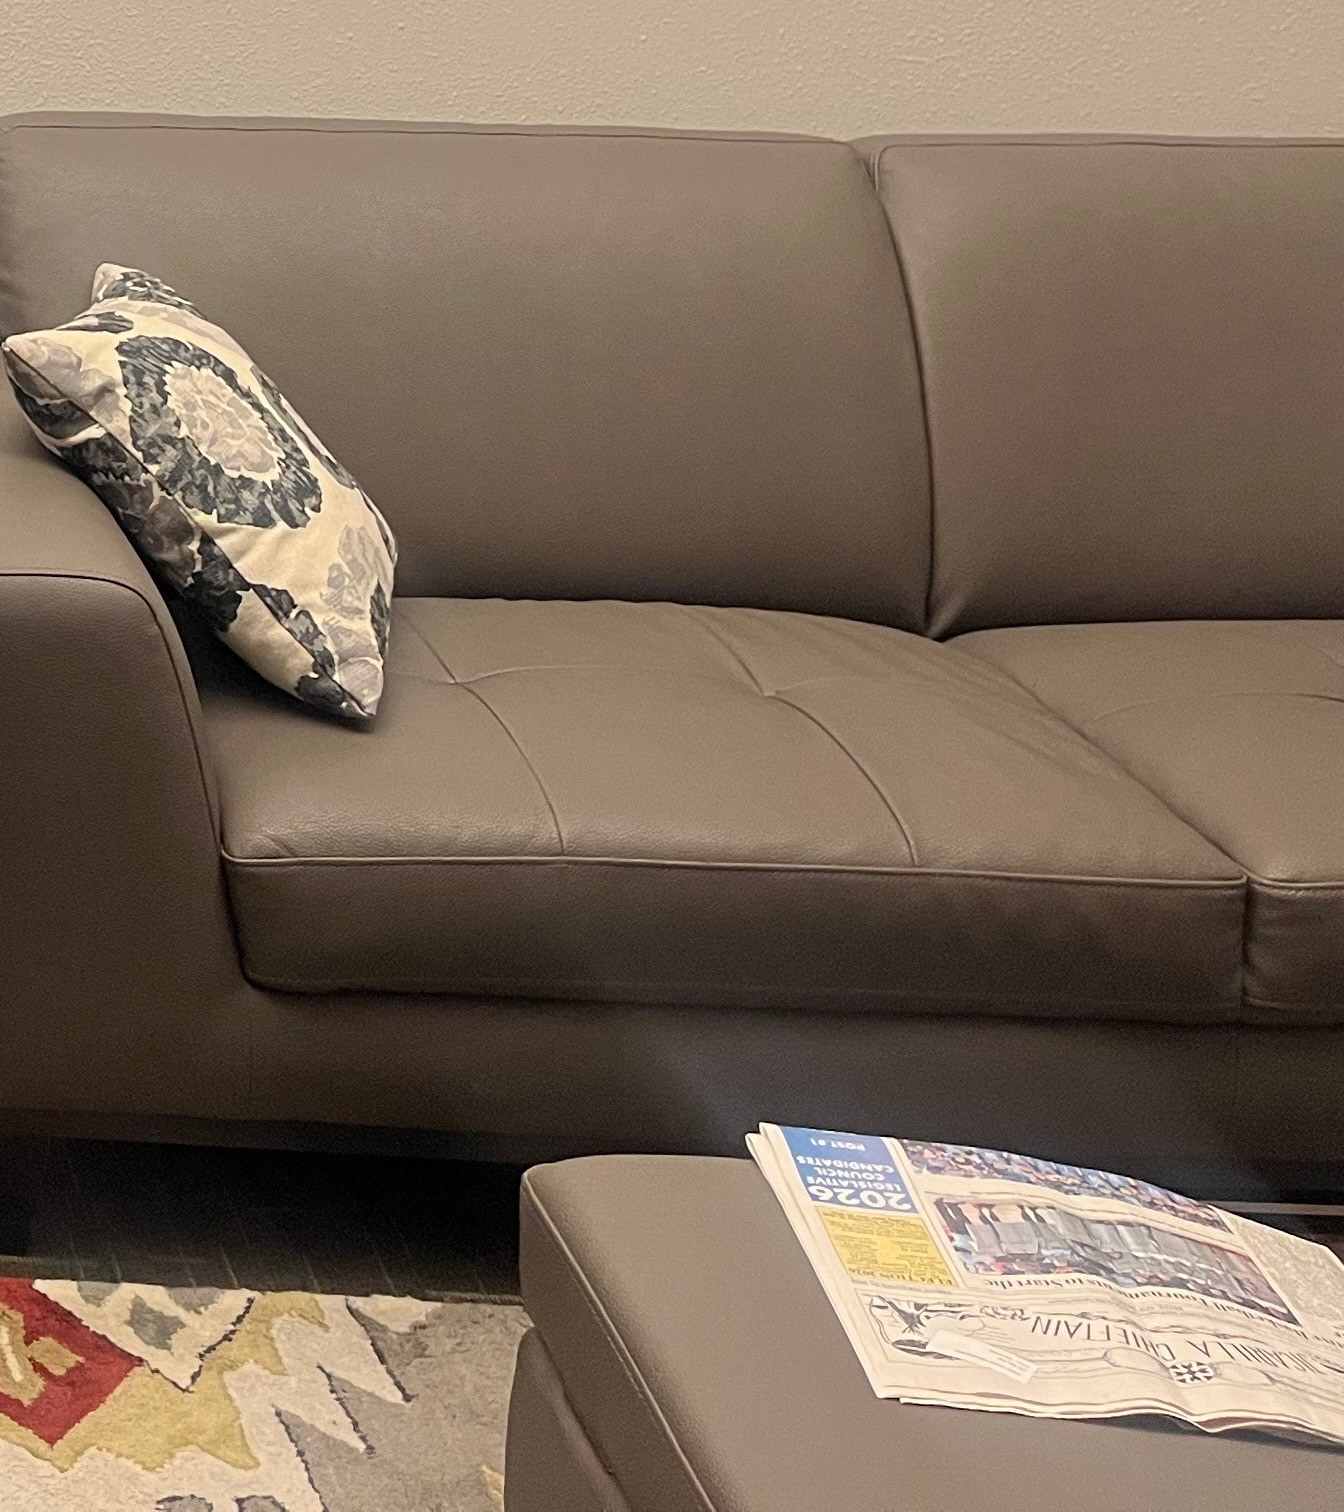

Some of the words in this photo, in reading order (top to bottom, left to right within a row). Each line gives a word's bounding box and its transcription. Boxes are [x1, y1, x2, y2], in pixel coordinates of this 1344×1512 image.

[831, 1140, 866, 1152] POST
[796, 1155, 895, 1174] CANDIDATES
[814, 1166, 885, 1182] COUNCIL
[806, 1176, 902, 1192] LEGISLATIVE
[808, 1185, 912, 1211] 2026
[1064, 1277, 1084, 1285] to
[1031, 1315, 1177, 1362] CHIEFTAIN
